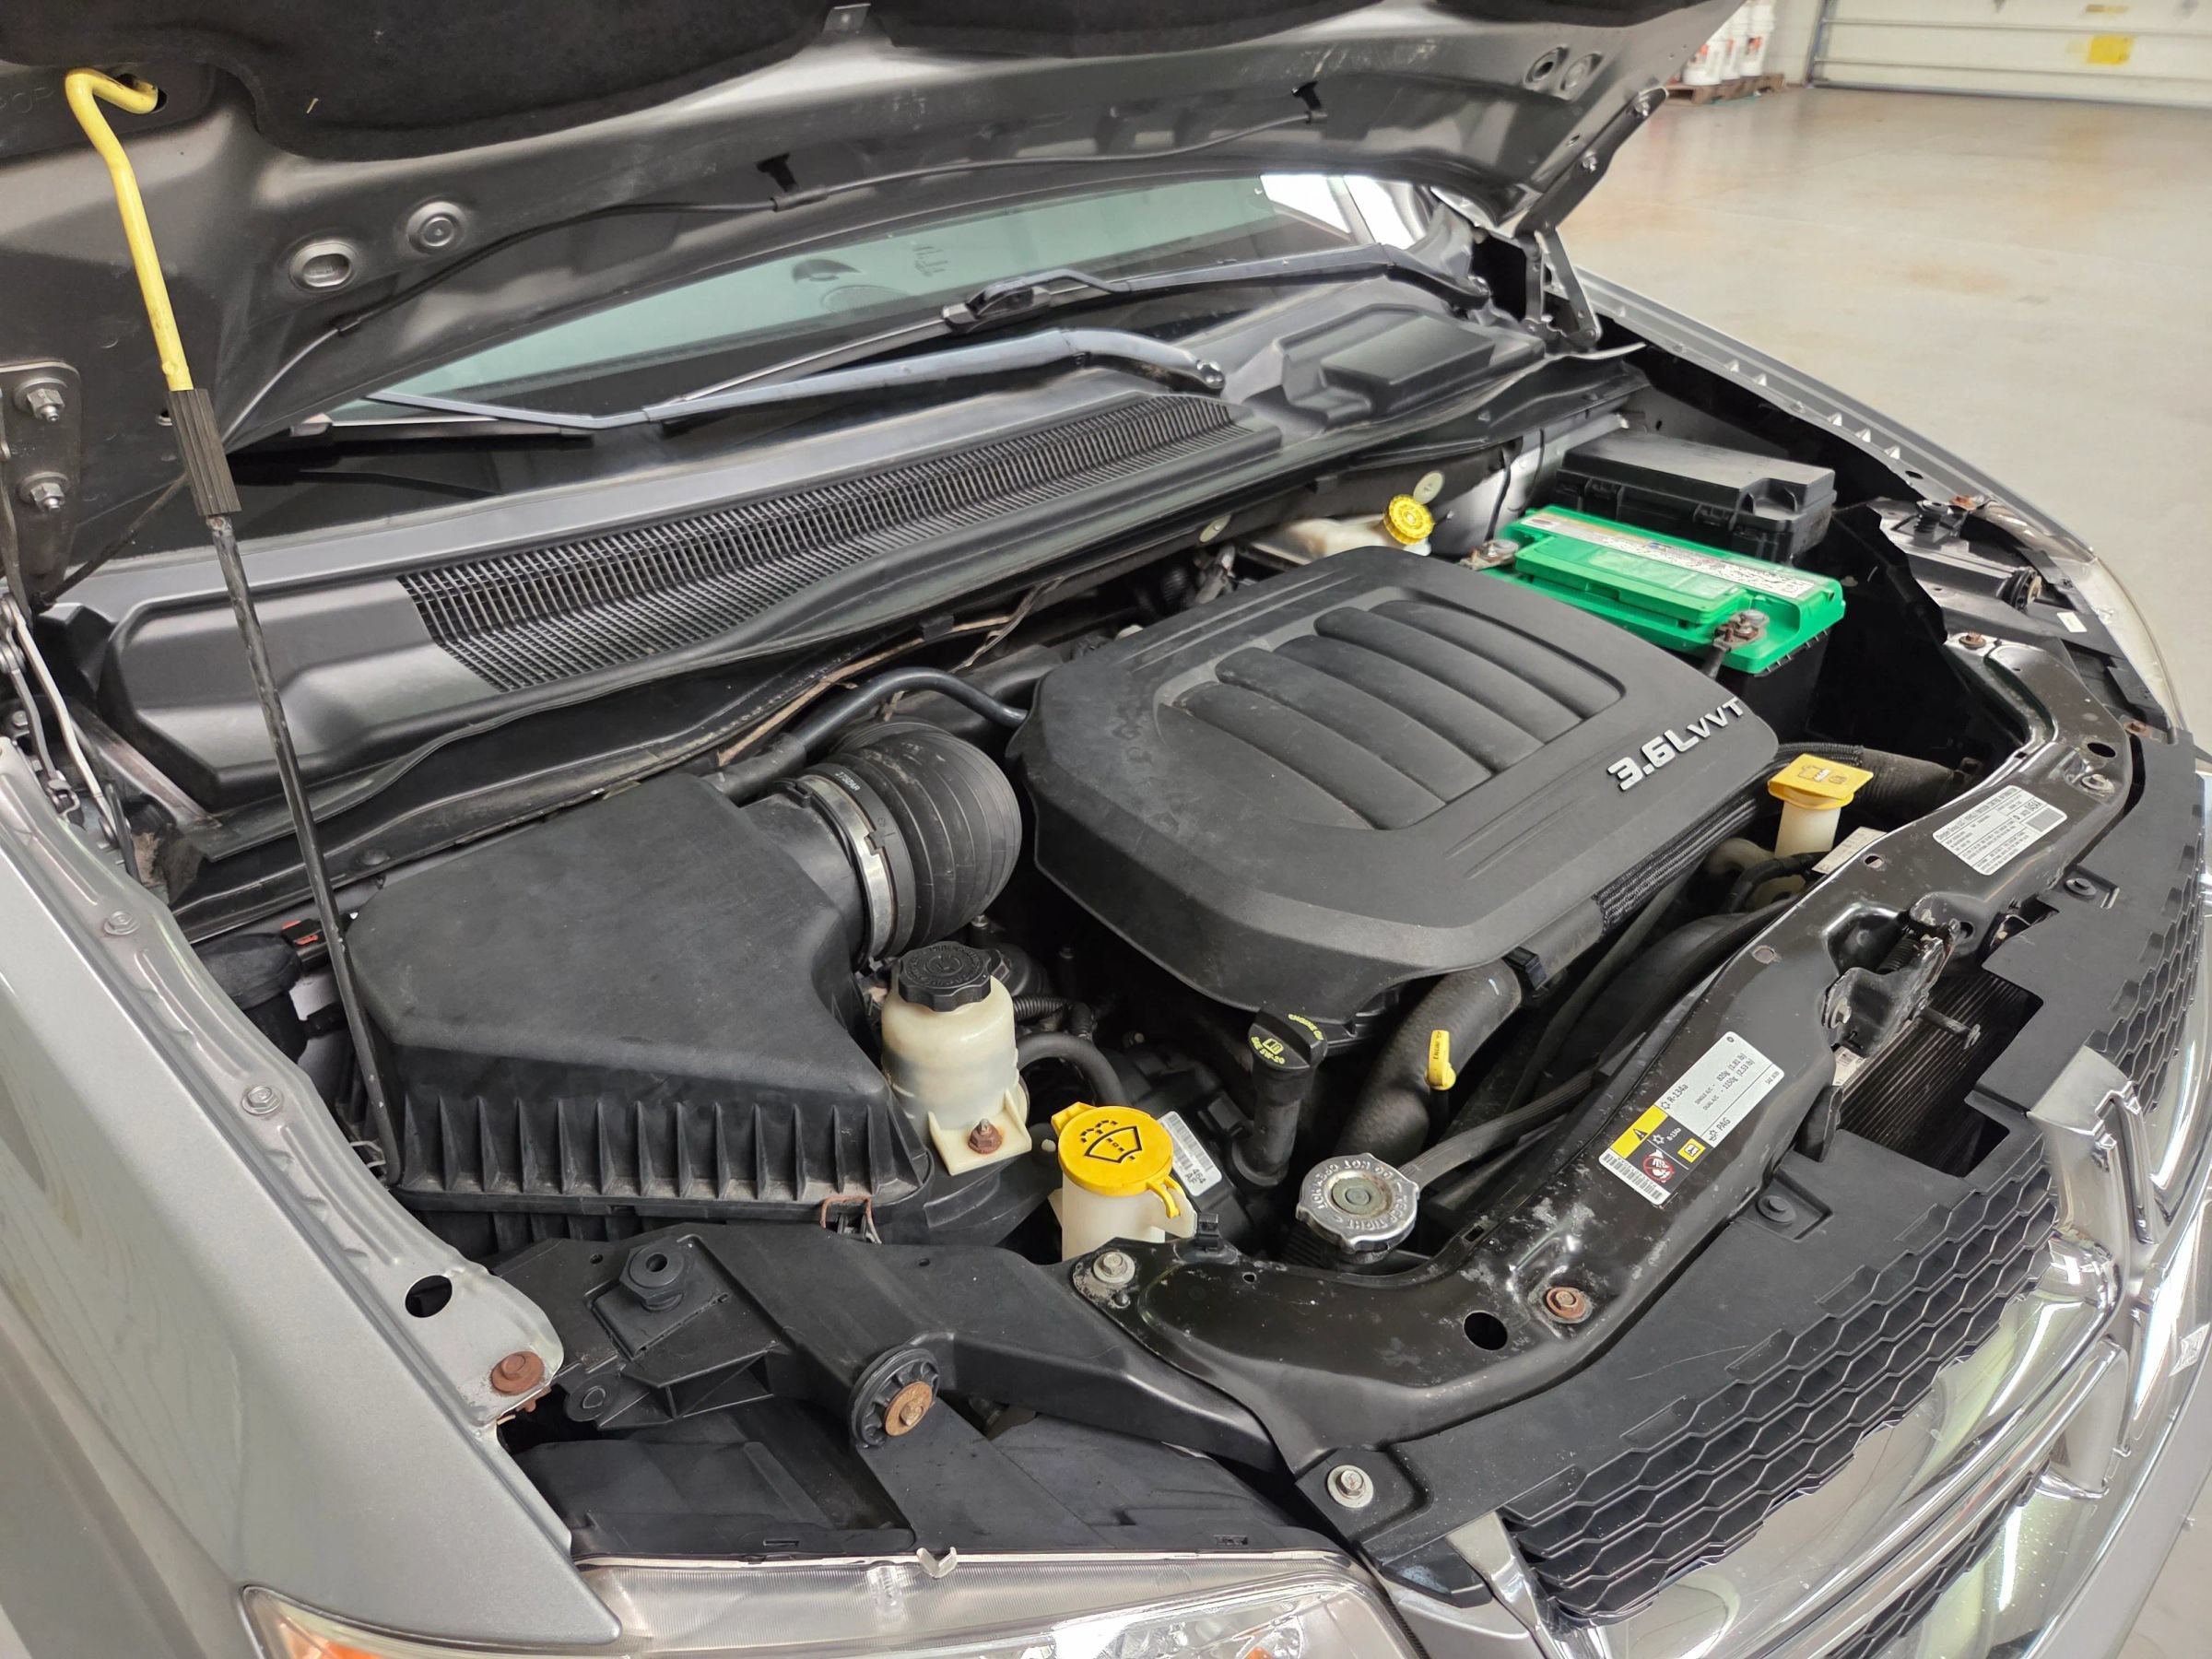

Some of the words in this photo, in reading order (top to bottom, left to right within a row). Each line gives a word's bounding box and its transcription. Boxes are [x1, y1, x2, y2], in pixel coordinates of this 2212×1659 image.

[1666, 1084, 1688, 1103] R-134a
[1716, 1117, 1730, 1130] PAG
[1347, 1218, 1388, 1231] TIGHT
